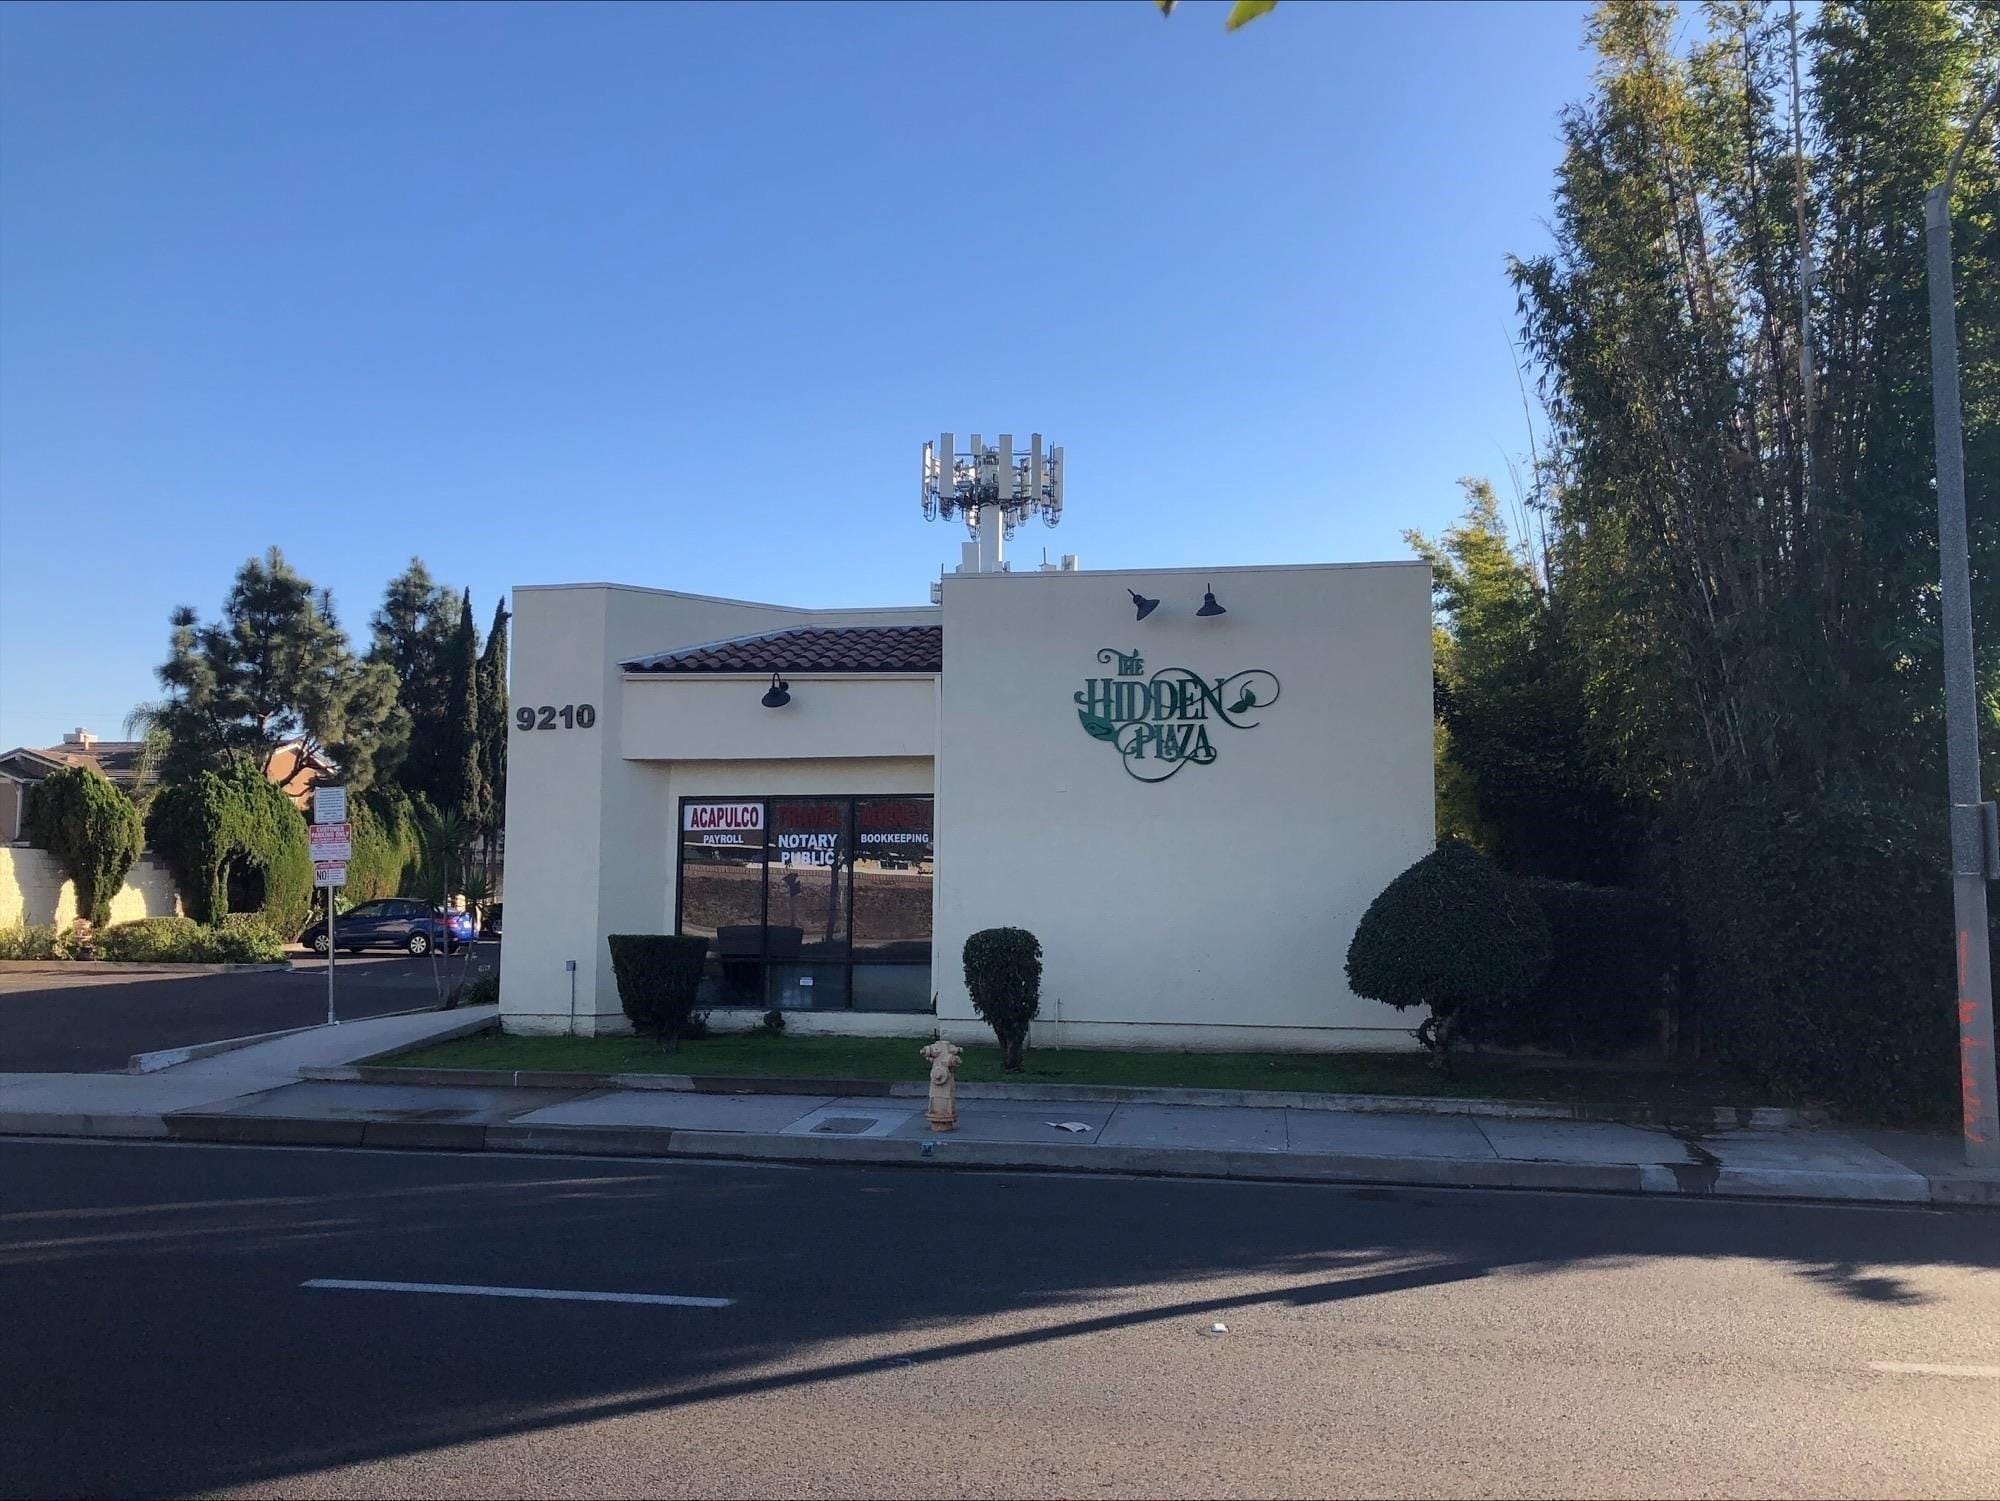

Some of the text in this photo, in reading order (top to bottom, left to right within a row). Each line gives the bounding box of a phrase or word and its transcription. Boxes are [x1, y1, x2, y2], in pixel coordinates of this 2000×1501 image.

[1109, 651, 1144, 676] THE
[1074, 676, 1235, 724] HIDDEN
[516, 703, 596, 731] 9210
[1122, 722, 1215, 765] PLAZA
[690, 806, 759, 828] ACAPULCO
[703, 834, 744, 844] PAYROLL
[778, 833, 838, 848] NOTARY
[860, 833, 929, 844] BOOKKEEPING
[781, 851, 836, 866] PUBLIC
[316, 870, 327, 881] NO
